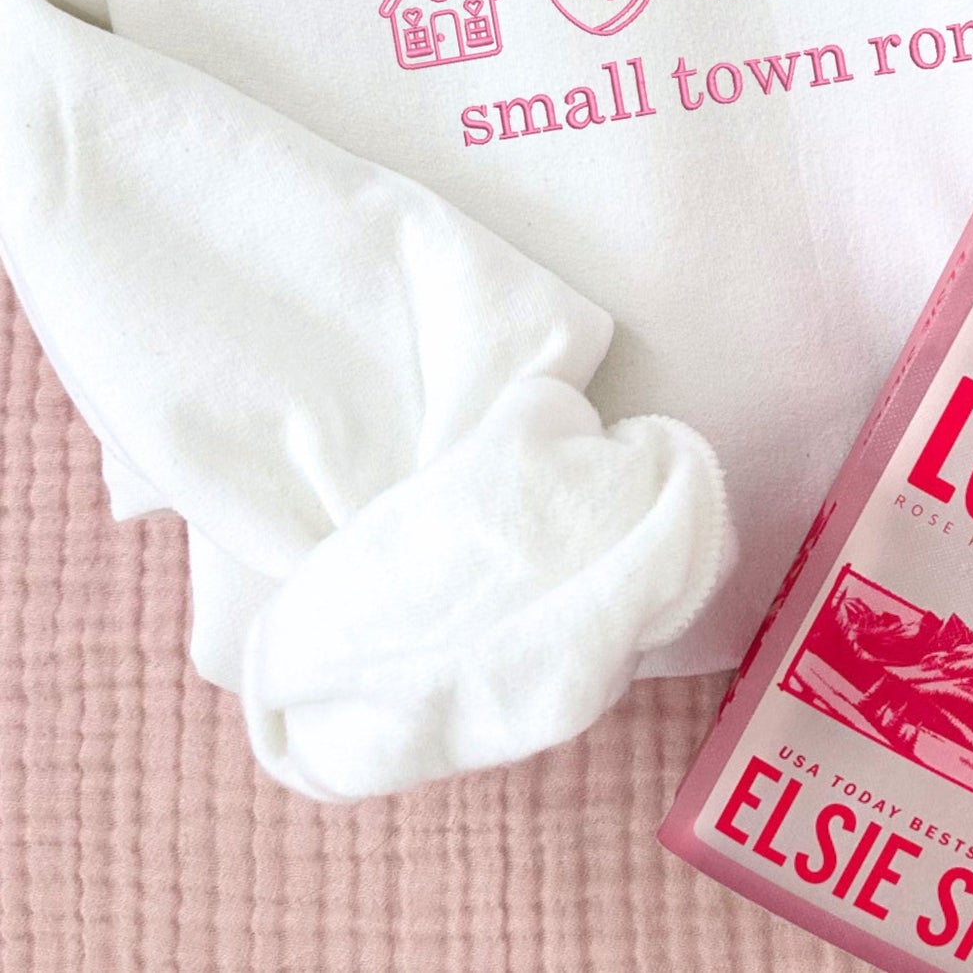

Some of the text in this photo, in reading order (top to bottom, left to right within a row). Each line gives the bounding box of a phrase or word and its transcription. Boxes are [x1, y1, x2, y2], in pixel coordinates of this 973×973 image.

[461, 56, 657, 147] small
[671, 44, 854, 111] town
[894, 494, 953, 535] ROSE
[778, 746, 820, 779] USA
[831, 775, 903, 819] TODAY
[715, 756, 923, 920] ELSIE
